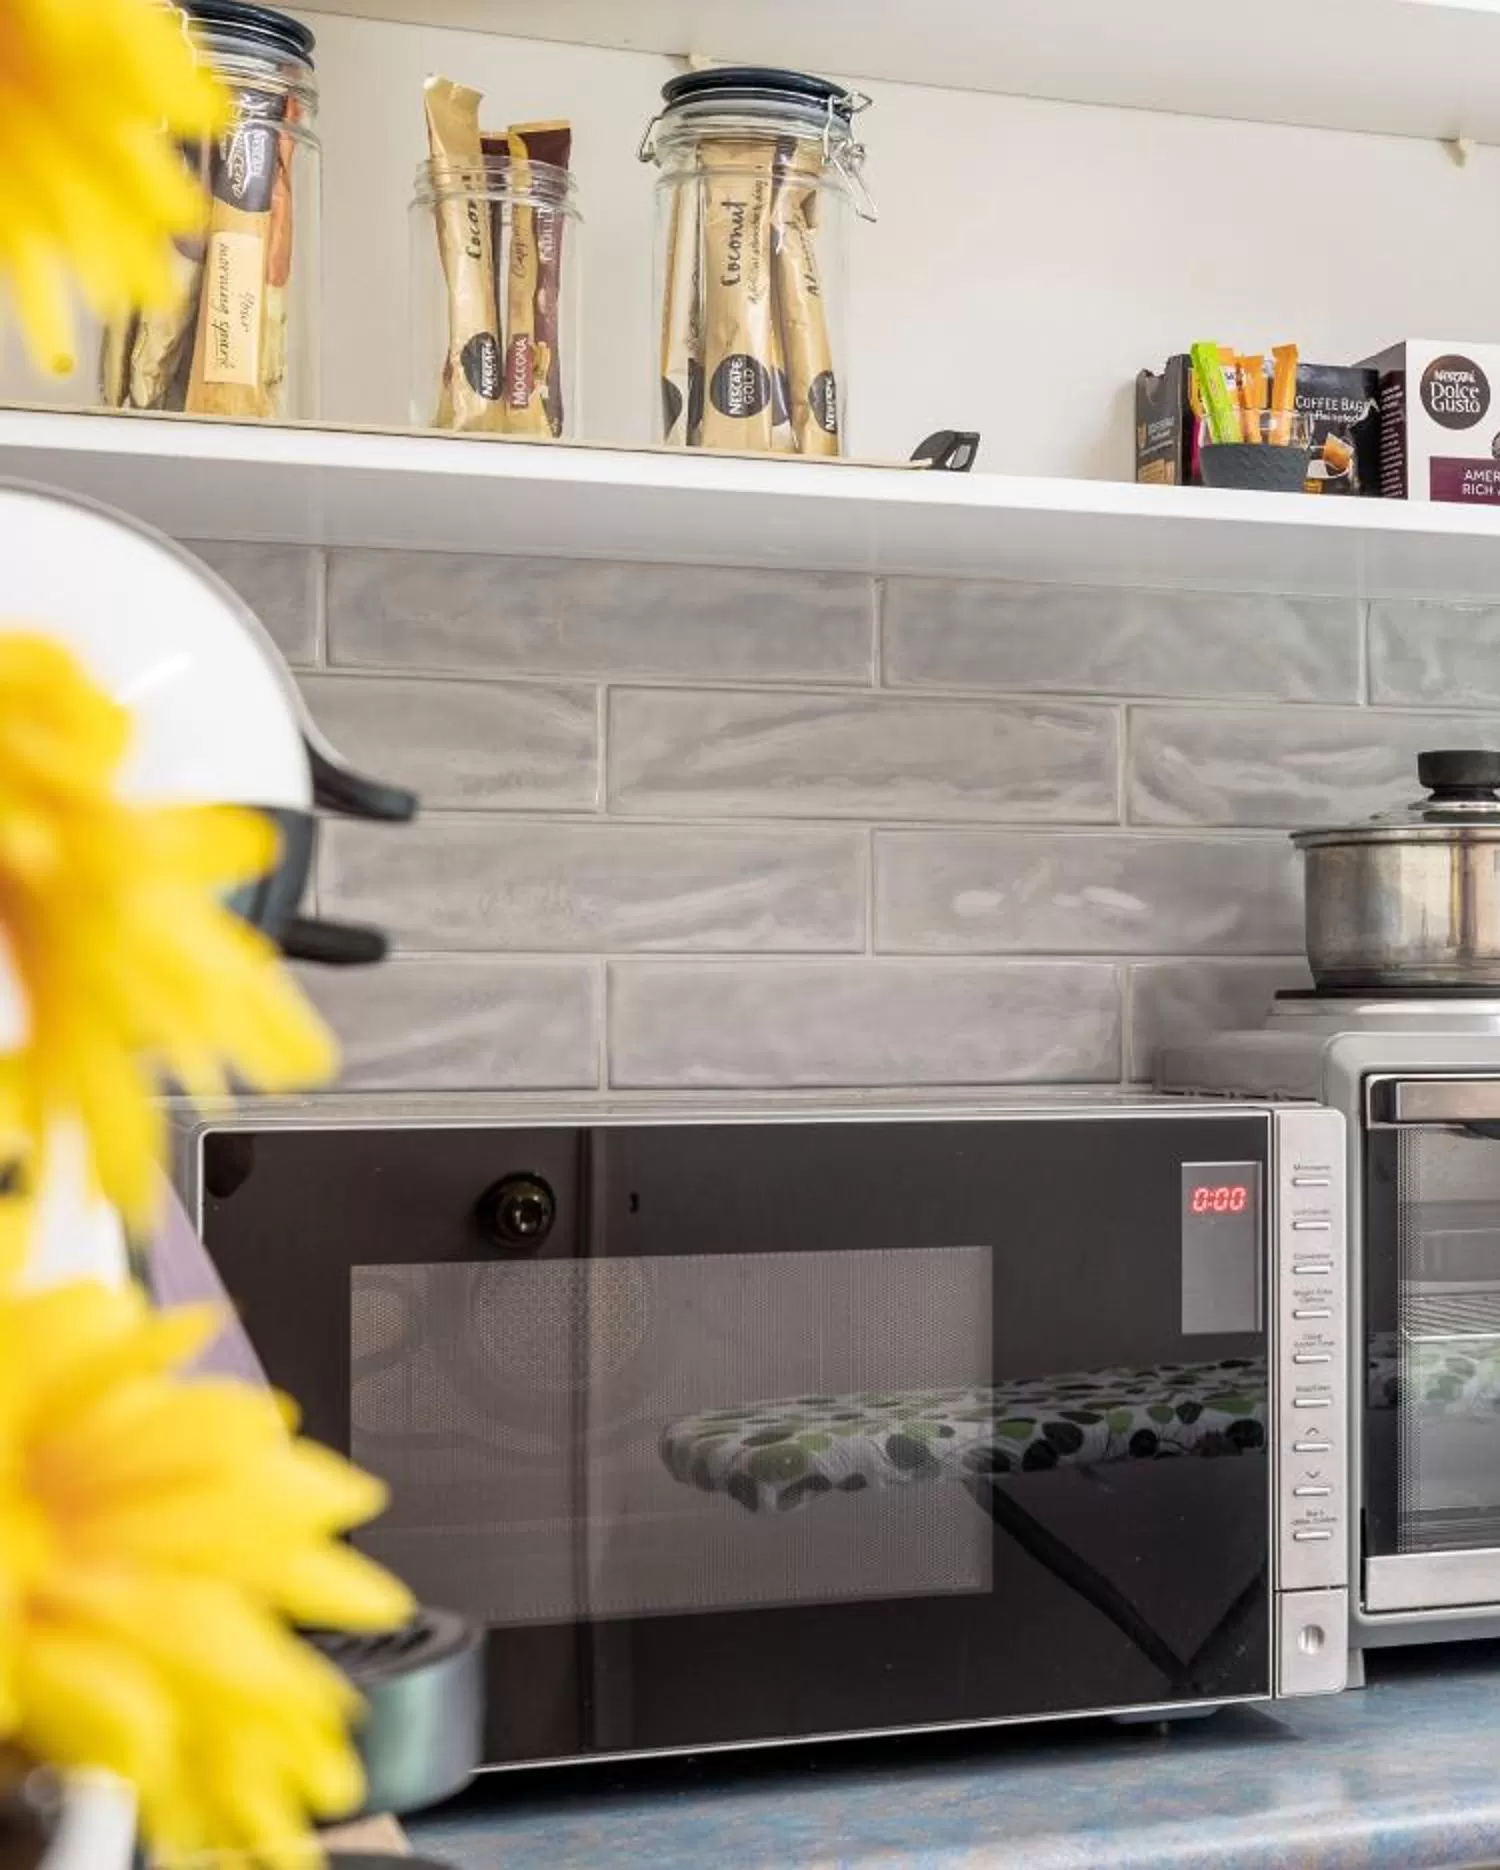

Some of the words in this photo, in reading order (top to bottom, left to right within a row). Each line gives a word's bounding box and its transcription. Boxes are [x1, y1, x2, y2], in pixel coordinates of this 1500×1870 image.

[720, 200, 748, 286] Coconut
[511, 337, 528, 406] MOCCONA
[743, 368, 757, 406] GOLD
[1429, 381, 1480, 400] Dolce
[1295, 395, 1339, 411] COFFEE
[1430, 397, 1481, 413] Gusto
[1461, 483, 1494, 496] RICH
[1193, 1187, 1246, 1212] 0:00
